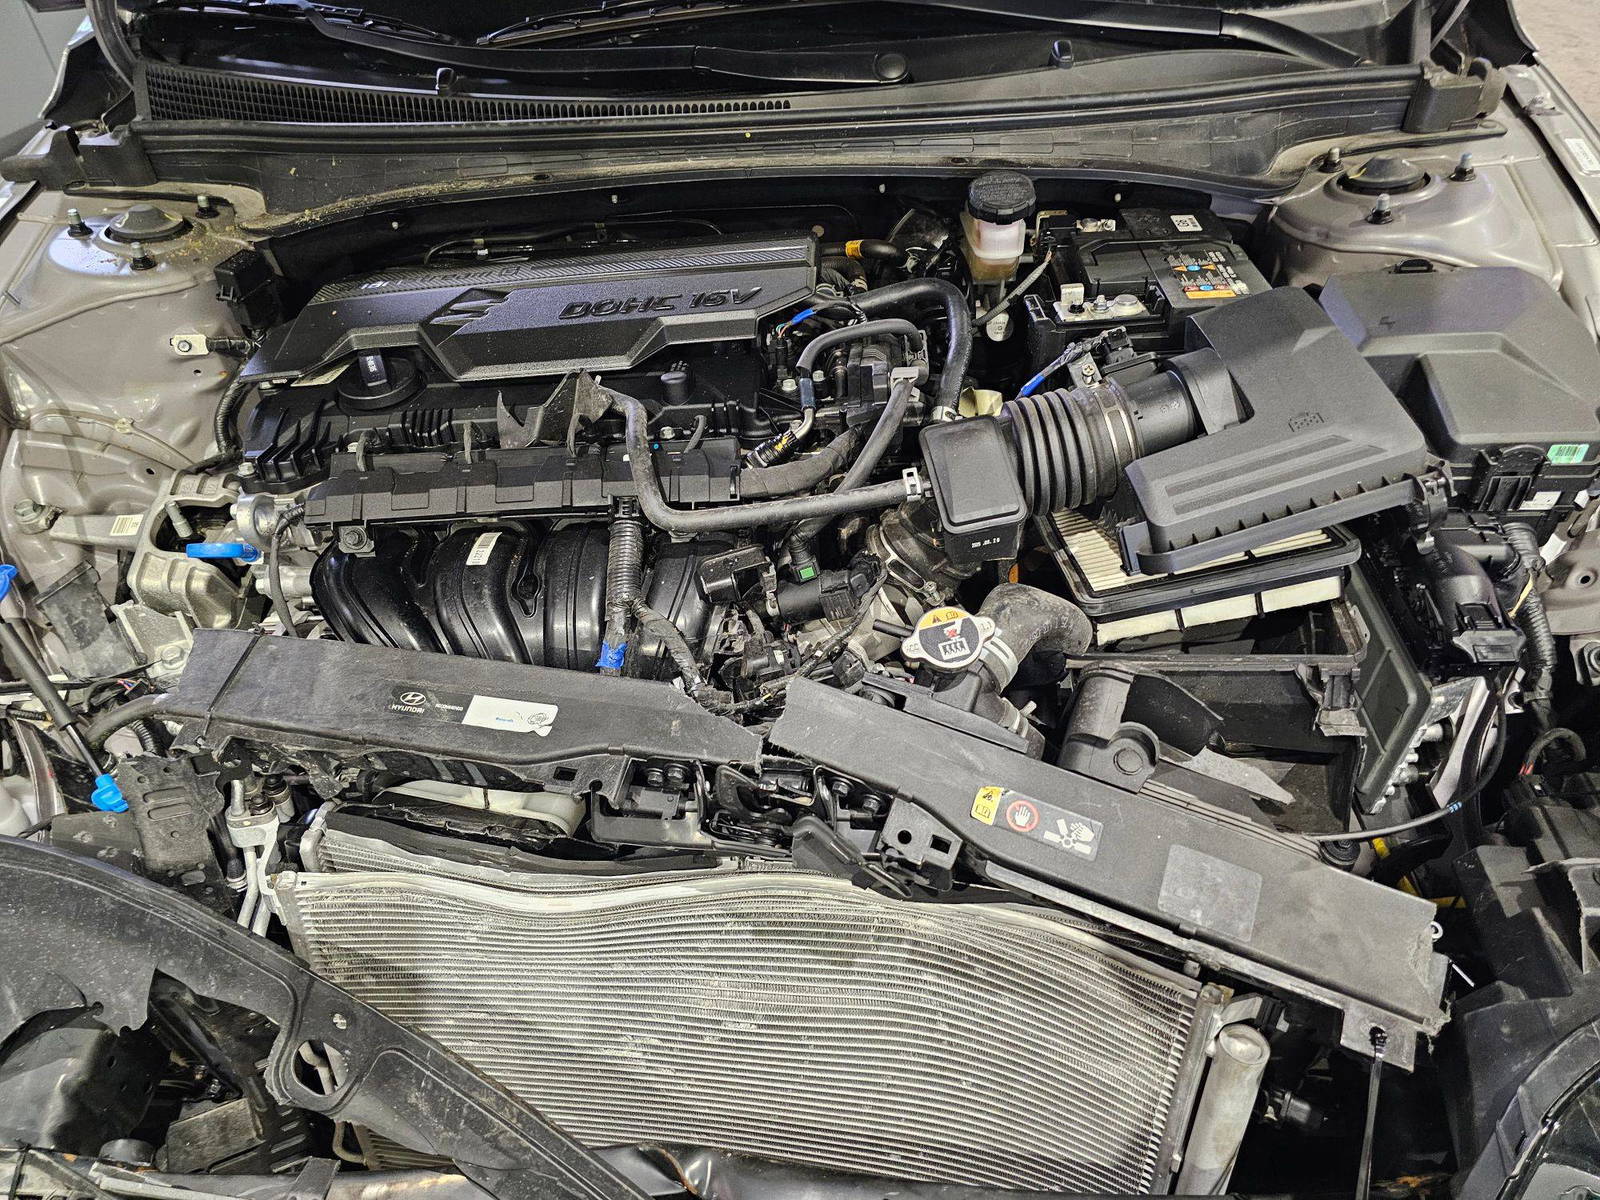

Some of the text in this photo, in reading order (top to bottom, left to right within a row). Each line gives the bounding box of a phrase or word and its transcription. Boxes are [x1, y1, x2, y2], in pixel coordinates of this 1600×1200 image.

[559, 286, 763, 319] DOHC 16V
[390, 704, 425, 714] HYUNDAI
